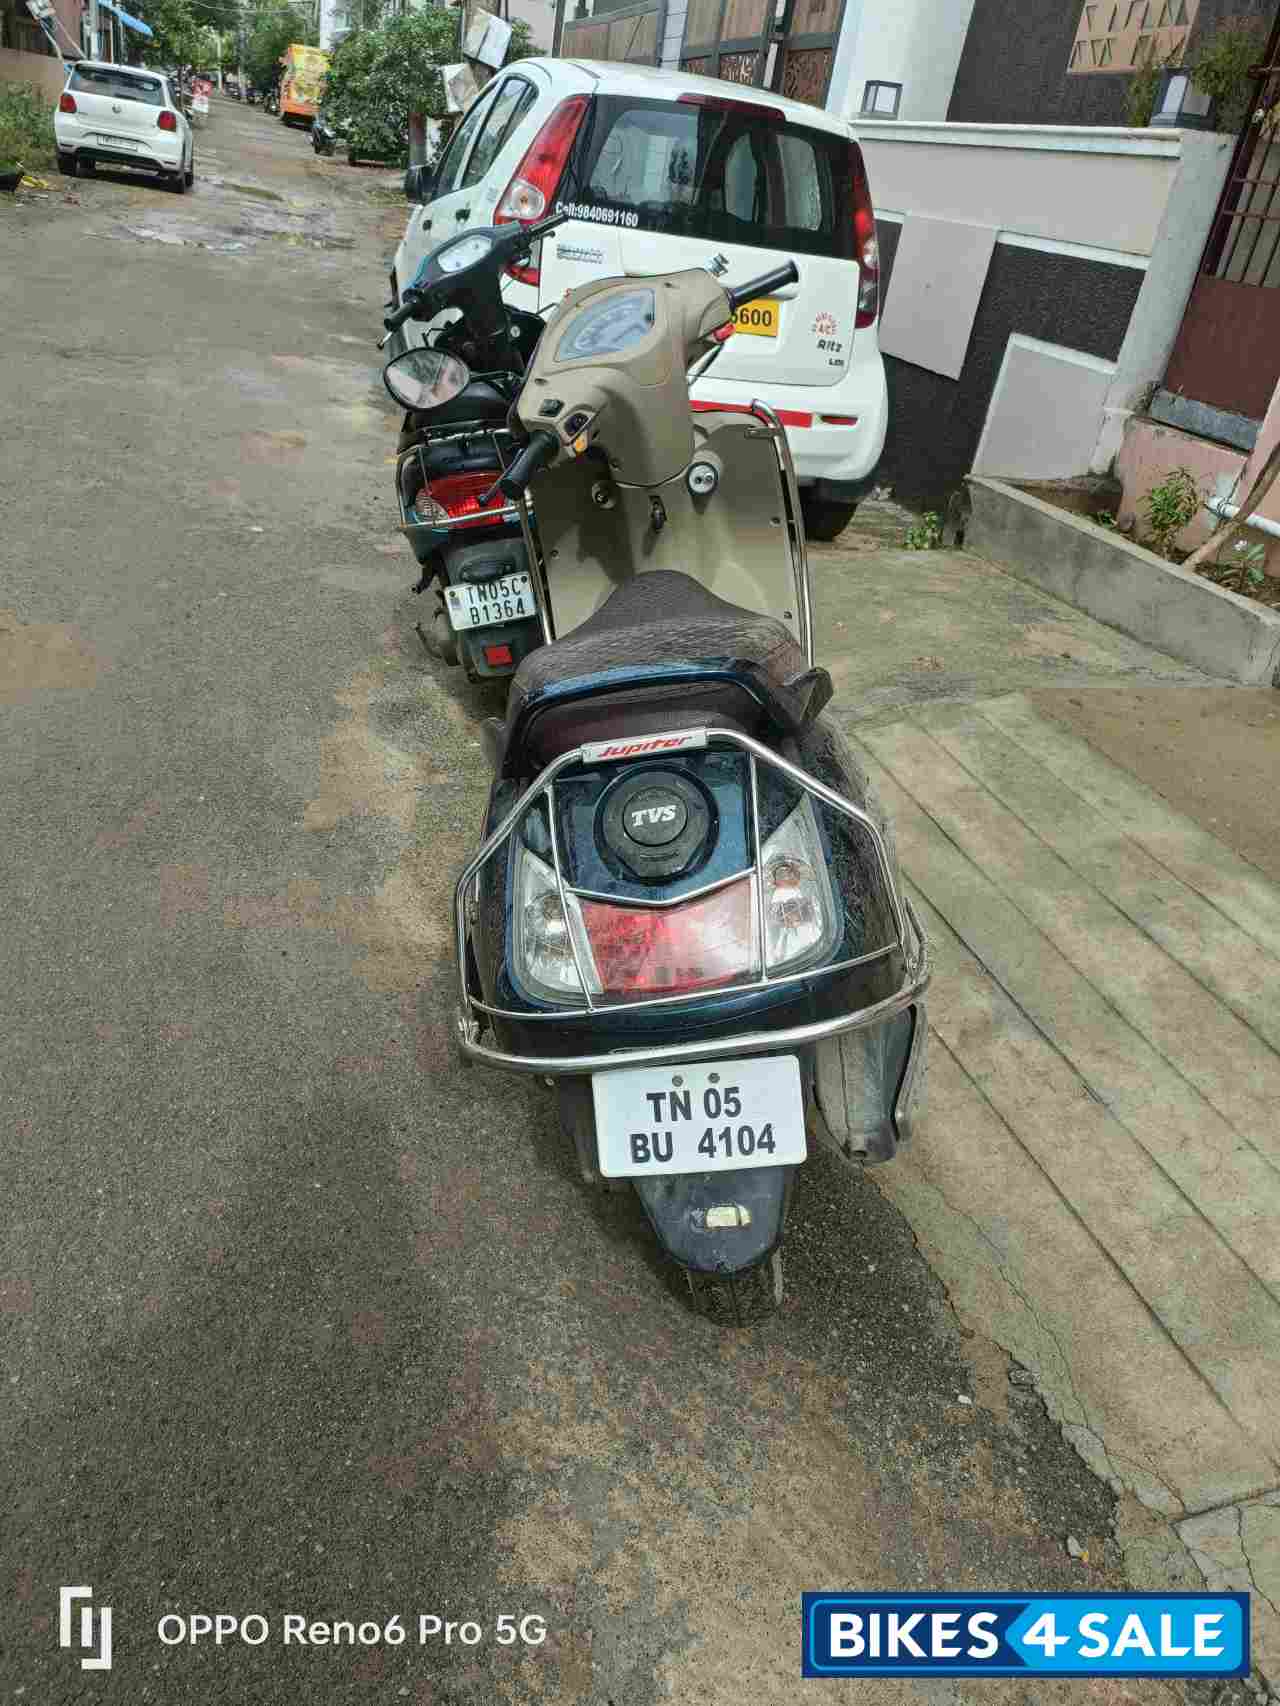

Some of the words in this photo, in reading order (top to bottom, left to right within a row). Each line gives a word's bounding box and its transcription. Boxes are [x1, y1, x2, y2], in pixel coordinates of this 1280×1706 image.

[597, 736, 693, 758] Jupiter
[631, 804, 678, 827] TVS
[646, 1090, 692, 1123] TN
[703, 1086, 742, 1119] 05
[629, 1131, 674, 1164] BU
[697, 1123, 776, 1158] 4104
